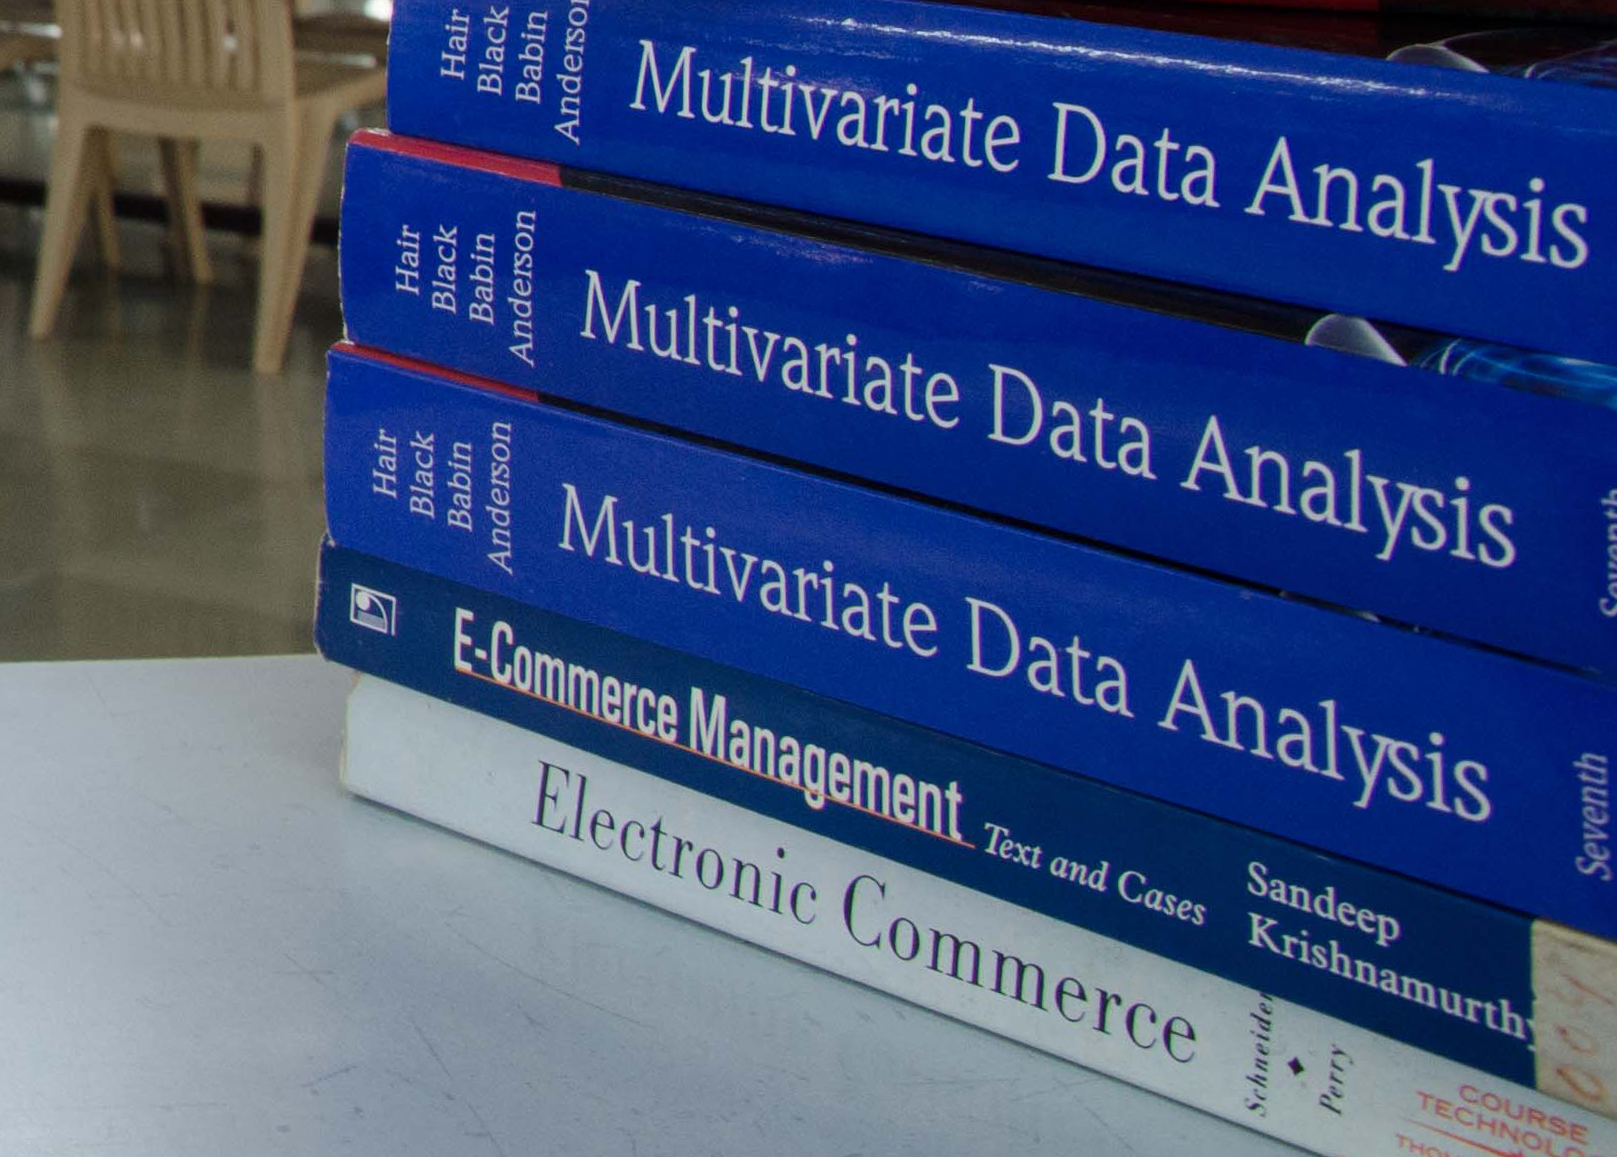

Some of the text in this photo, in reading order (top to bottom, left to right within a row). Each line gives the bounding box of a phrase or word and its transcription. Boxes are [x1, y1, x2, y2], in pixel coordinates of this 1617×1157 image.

[440, 9, 470, 81] Hair
[477, 4, 510, 97] Black
[515, 9, 548, 106] Babin
[629, 39, 1590, 273] Multivariate Data Analysis
[395, 224, 420, 295] Hair
[432, 223, 458, 315] Black
[468, 231, 496, 326] Babin
[508, 209, 537, 369] Anderson
[373, 428, 398, 499] Hair
[579, 269, 961, 430] Multivariate
[987, 363, 1158, 481] Data
[1180, 414, 1518, 569] Analysis
[410, 429, 436, 520] Black
[447, 441, 473, 533] Babin
[486, 419, 513, 577] Anderson
[558, 482, 1494, 823] Multivariate Data Analysis
[454, 608, 1206, 927] E-Commerce Management Text and Cases
[1572, 752, 1614, 882] Seventh
[530, 759, 1197, 1064] Electronic Commerce
[1247, 861, 1401, 946] Sandeep
[1247, 912, 1536, 1053] Krishnamurth
[1244, 993, 1273, 1118] Schneider
[1319, 1043, 1354, 1116] Perry
[1415, 1090, 1600, 1157] TECHNOLO
[1458, 1084, 1590, 1147] COURSE
